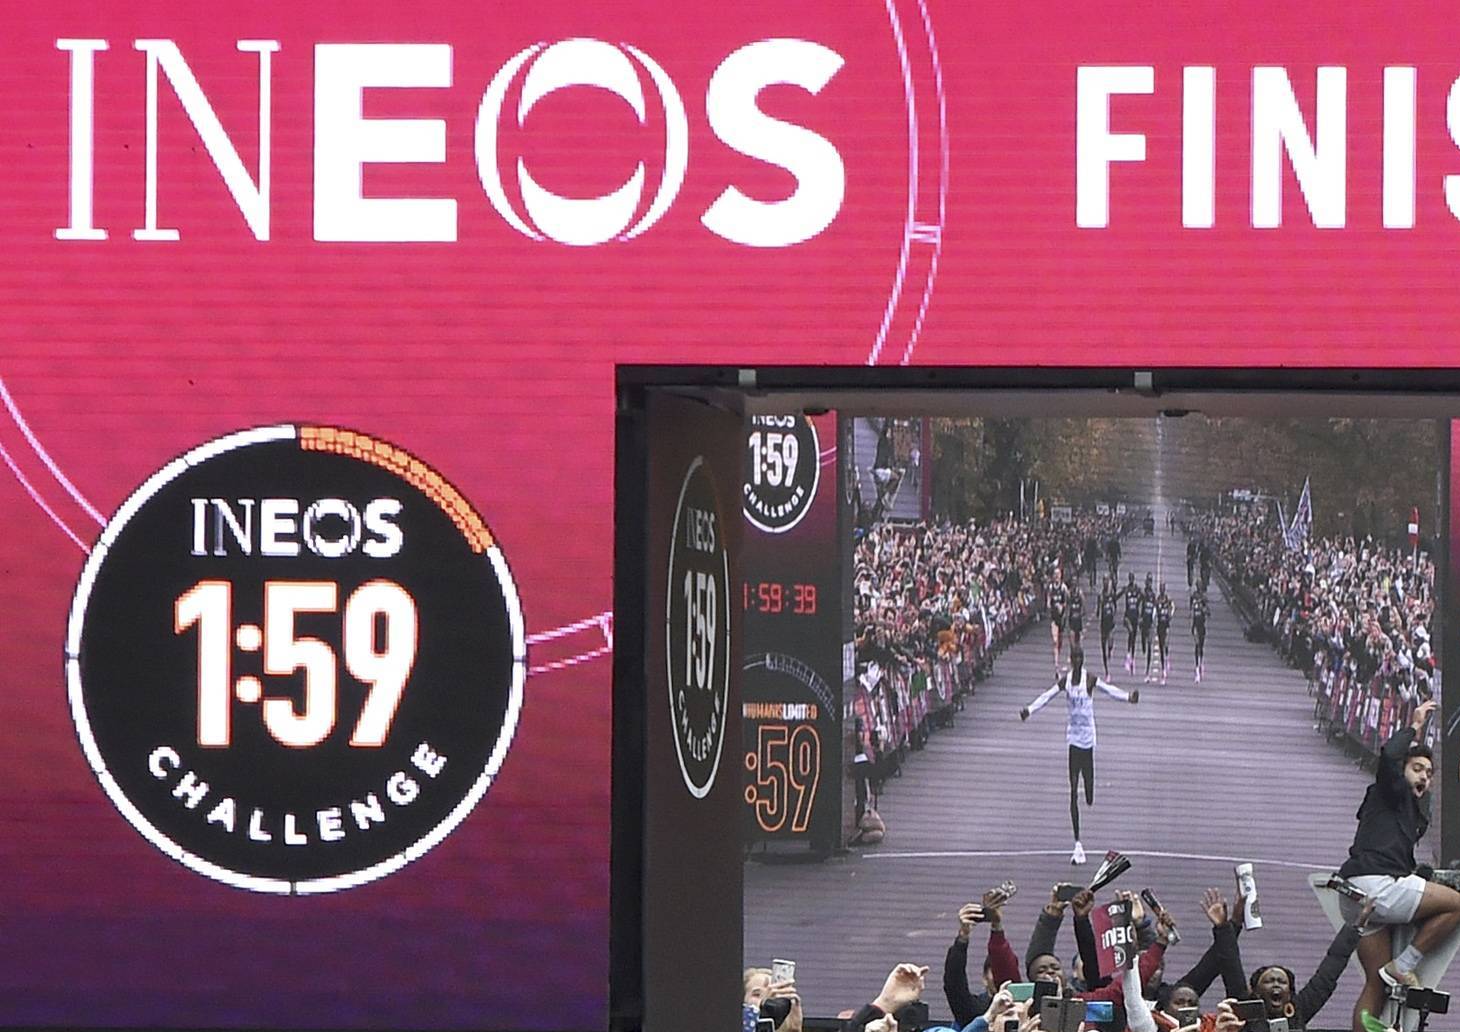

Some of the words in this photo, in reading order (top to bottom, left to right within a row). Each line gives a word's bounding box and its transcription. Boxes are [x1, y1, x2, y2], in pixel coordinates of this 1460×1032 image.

[54, 37, 846, 247] INEOS
[749, 432, 798, 487] 1:59
[191, 499, 404, 557] INEOS
[174, 578, 418, 748] 1:59
[684, 569, 717, 690] 1:59
[148, 741, 447, 844] CHALLENGE
